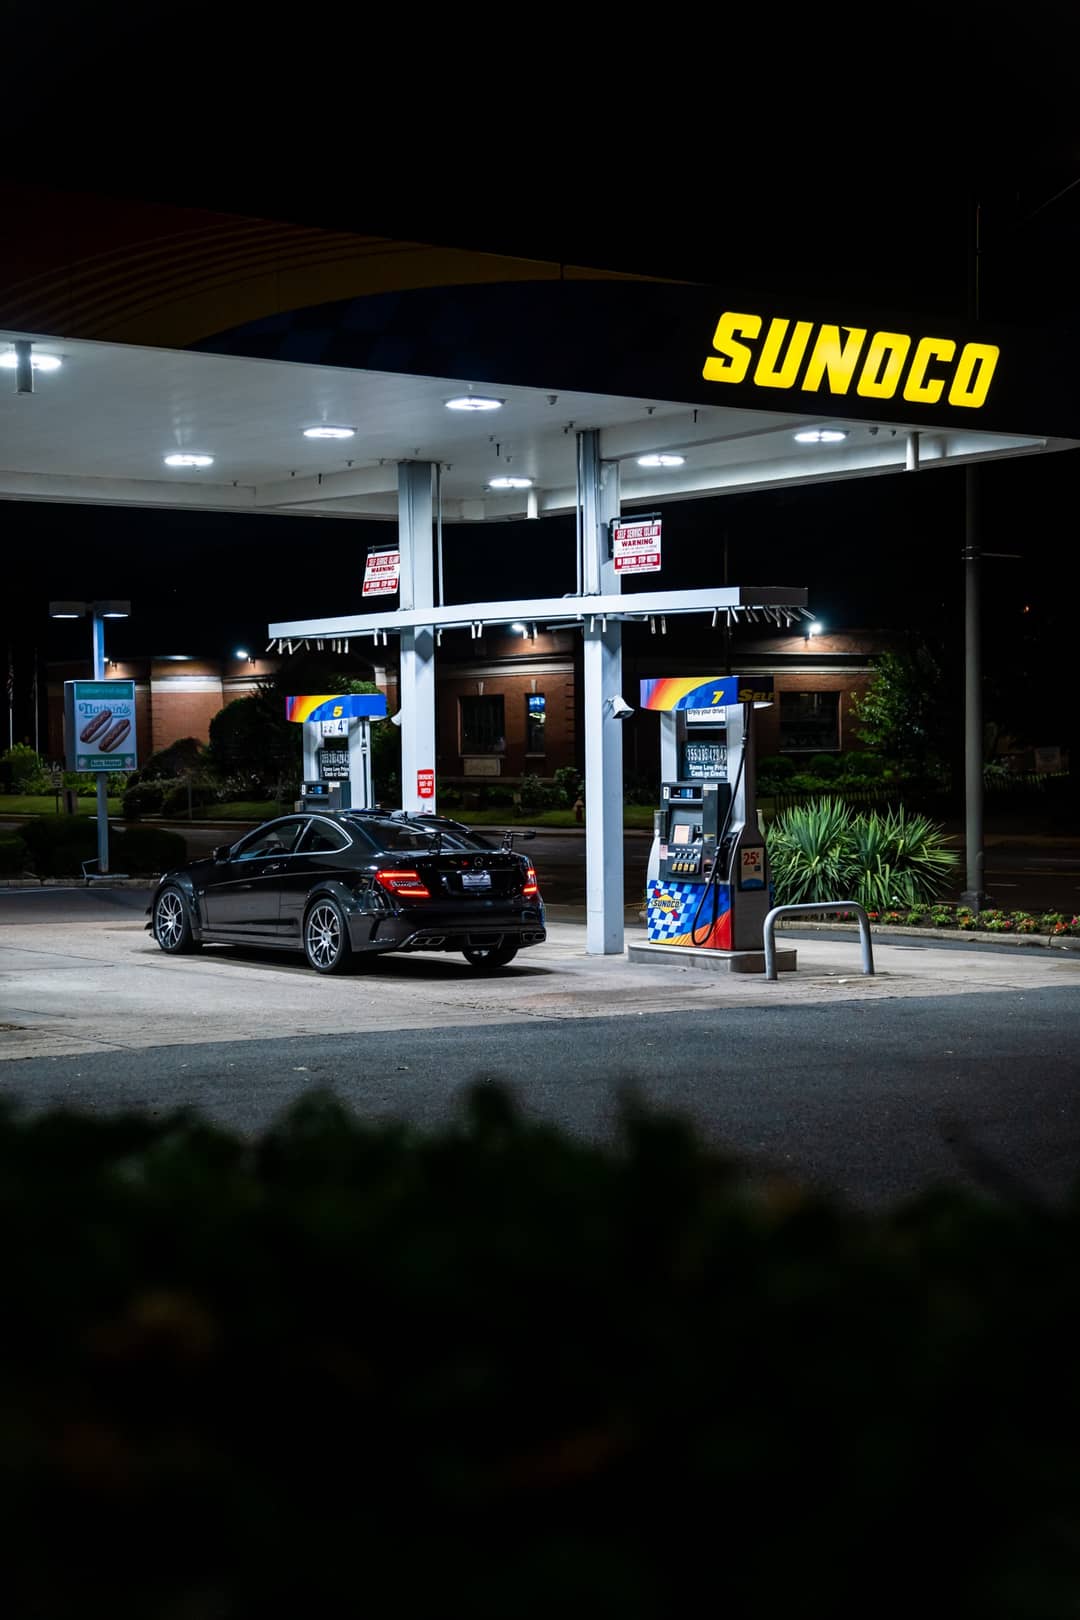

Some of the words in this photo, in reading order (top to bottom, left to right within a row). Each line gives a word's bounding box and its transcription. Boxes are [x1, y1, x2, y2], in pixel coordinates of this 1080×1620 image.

[702, 312, 1000, 408] SUNOCO
[622, 538, 653, 546] WARNING
[712, 691, 724, 704] 7
[333, 706, 343, 717] 5
[653, 899, 680, 908] SUNOCO
